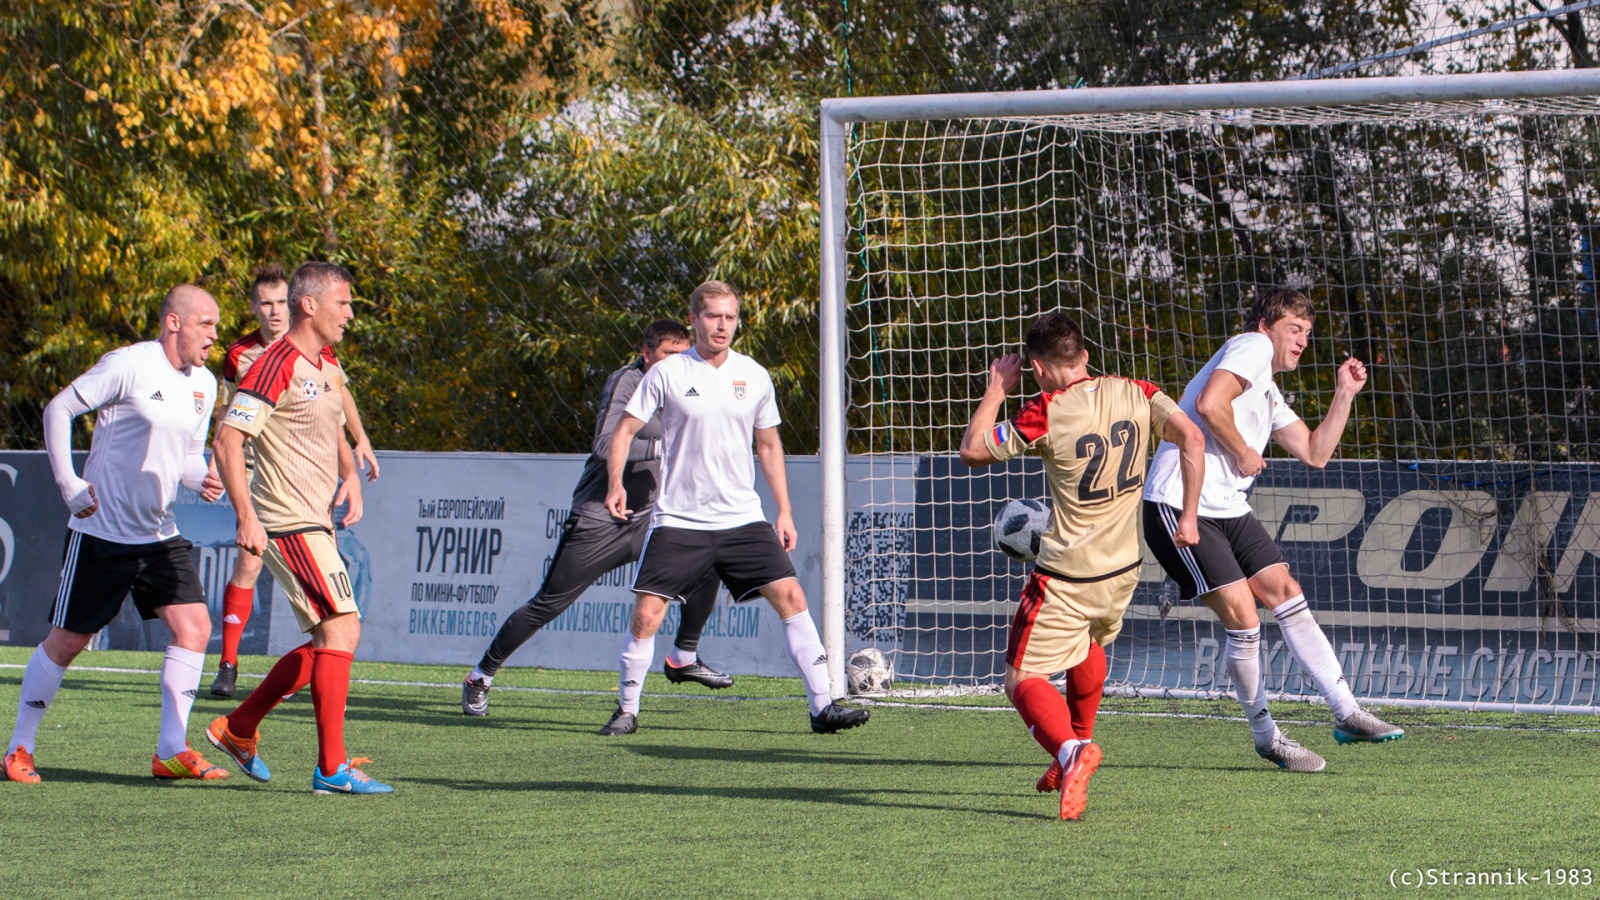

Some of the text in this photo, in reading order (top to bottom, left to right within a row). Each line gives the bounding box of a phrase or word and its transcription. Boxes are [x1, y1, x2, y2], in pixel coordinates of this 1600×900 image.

[229, 408, 255, 422] AFC
[1075, 420, 1143, 506] 22
[437, 496, 505, 520] ЕВРОПЕЙСКИЙ
[416, 526, 503, 575] ТУРНИР
[328, 571, 352, 601] 10
[411, 582, 500, 605] ПО МИНИ-ФУТБОЛУ
[409, 608, 497, 637] BIKKEMBERGS
[1465, 645, 1600, 702] СИСТЕ
